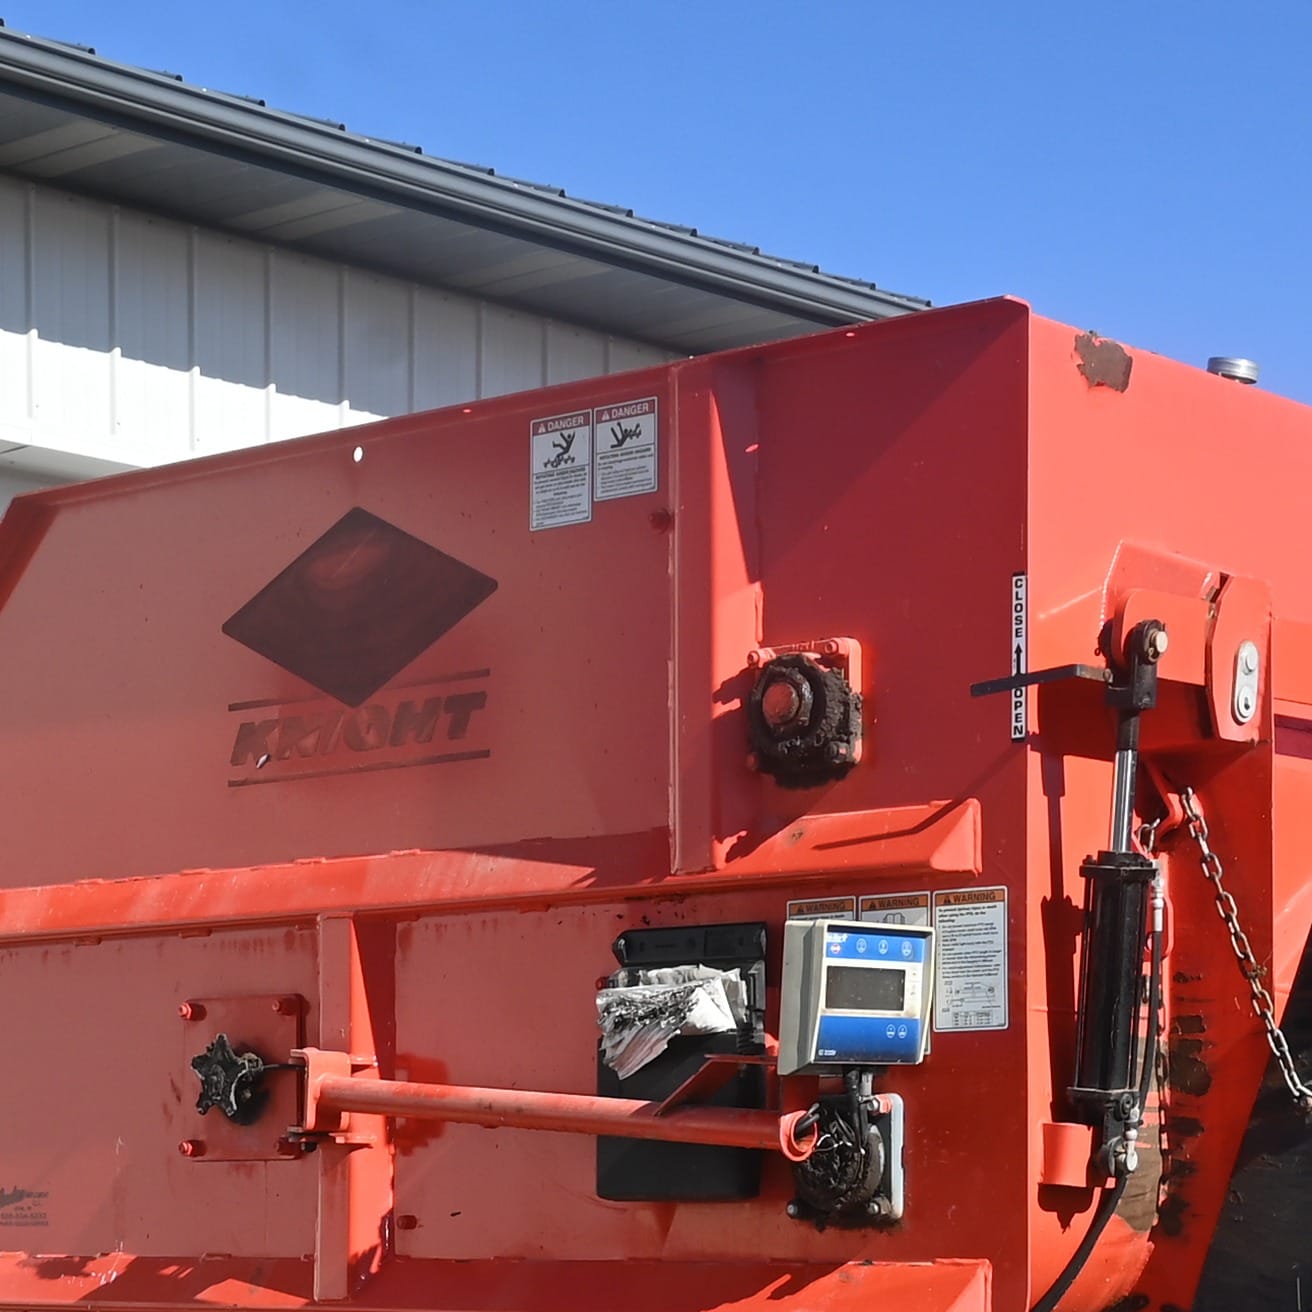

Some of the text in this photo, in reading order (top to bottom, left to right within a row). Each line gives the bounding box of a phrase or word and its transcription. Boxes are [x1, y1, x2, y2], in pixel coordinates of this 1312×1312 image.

[611, 402, 649, 419] DANGER
[547, 415, 584, 431] DANGER
[1014, 578, 1024, 638] CLOSE
[1013, 688, 1024, 735] OPEN
[878, 897, 919, 909] WARNING
[953, 892, 996, 903] WARNING
[805, 901, 846, 913] WARNING
